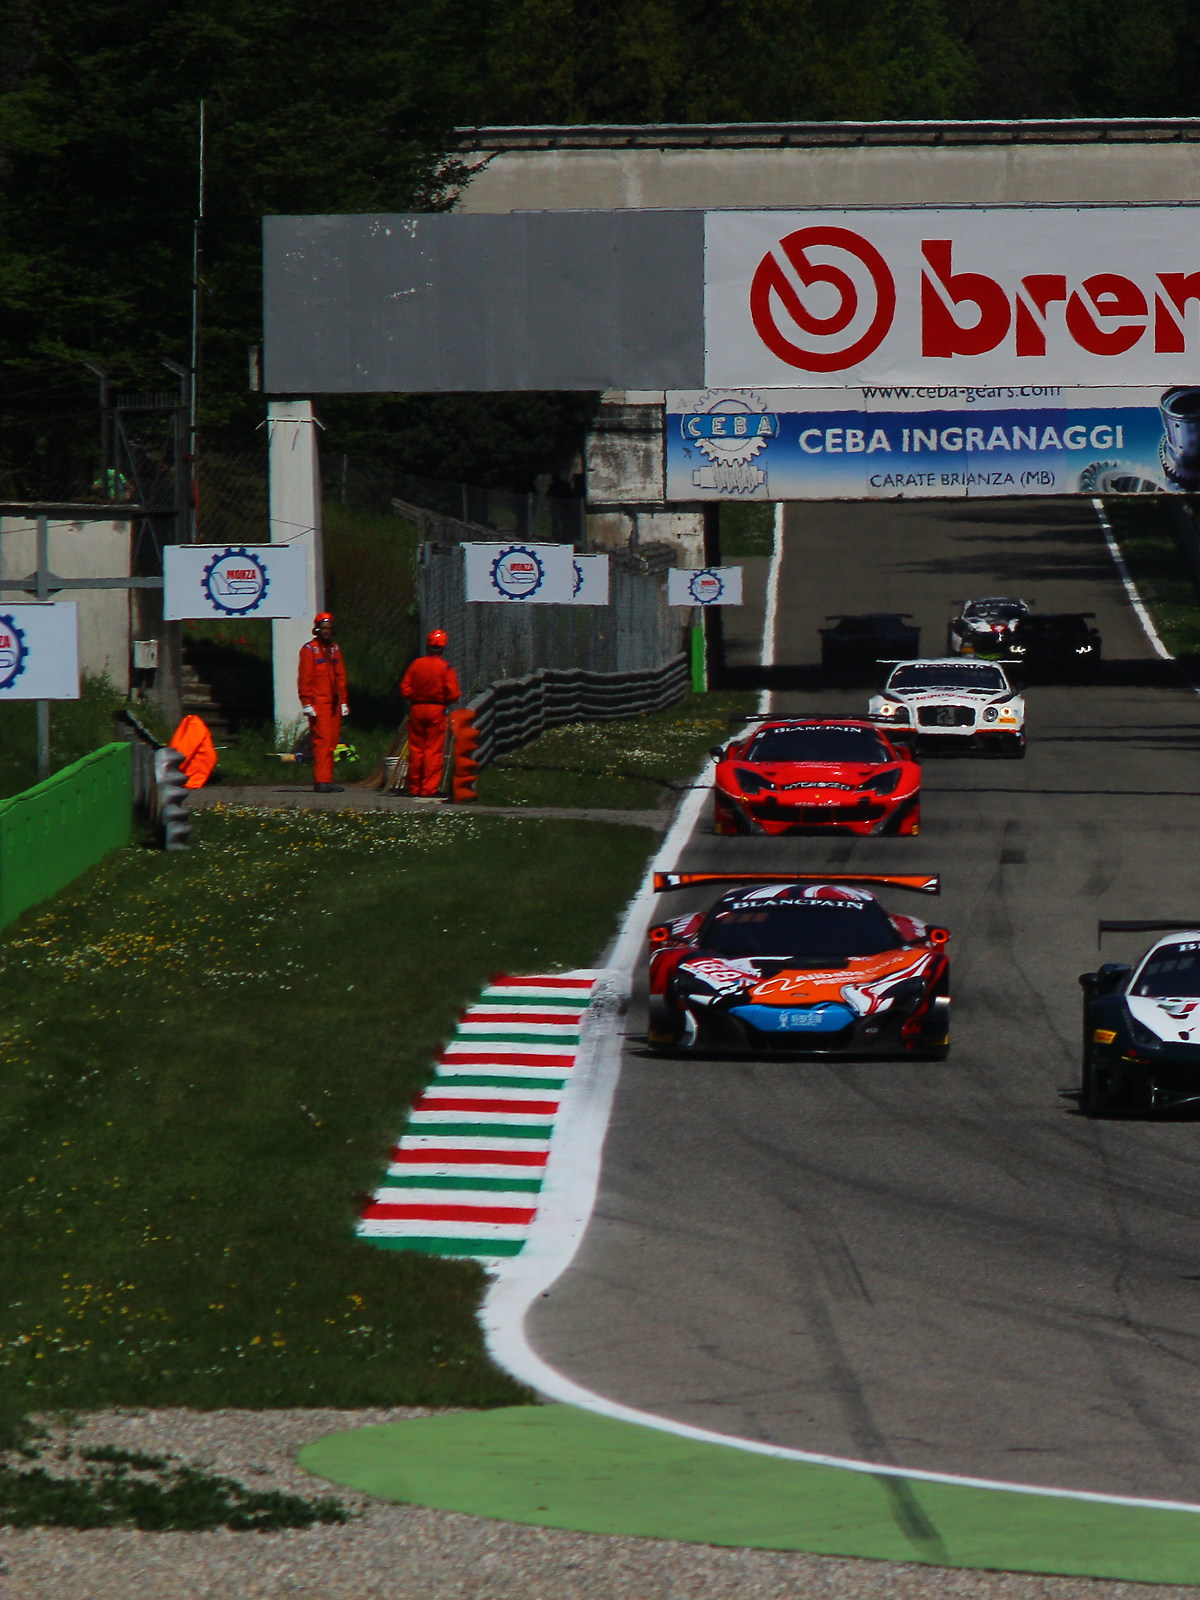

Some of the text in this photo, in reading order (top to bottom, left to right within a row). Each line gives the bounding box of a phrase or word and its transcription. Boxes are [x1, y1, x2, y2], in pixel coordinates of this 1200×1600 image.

[687, 416, 772, 436] CEBA
[799, 425, 1124, 453] CEBA INGRANAGGI
[869, 470, 1056, 489] CARATE BRIANZA (MB)
[227, 569, 257, 580] MONZA
[732, 899, 864, 910] BLANCPAIN
